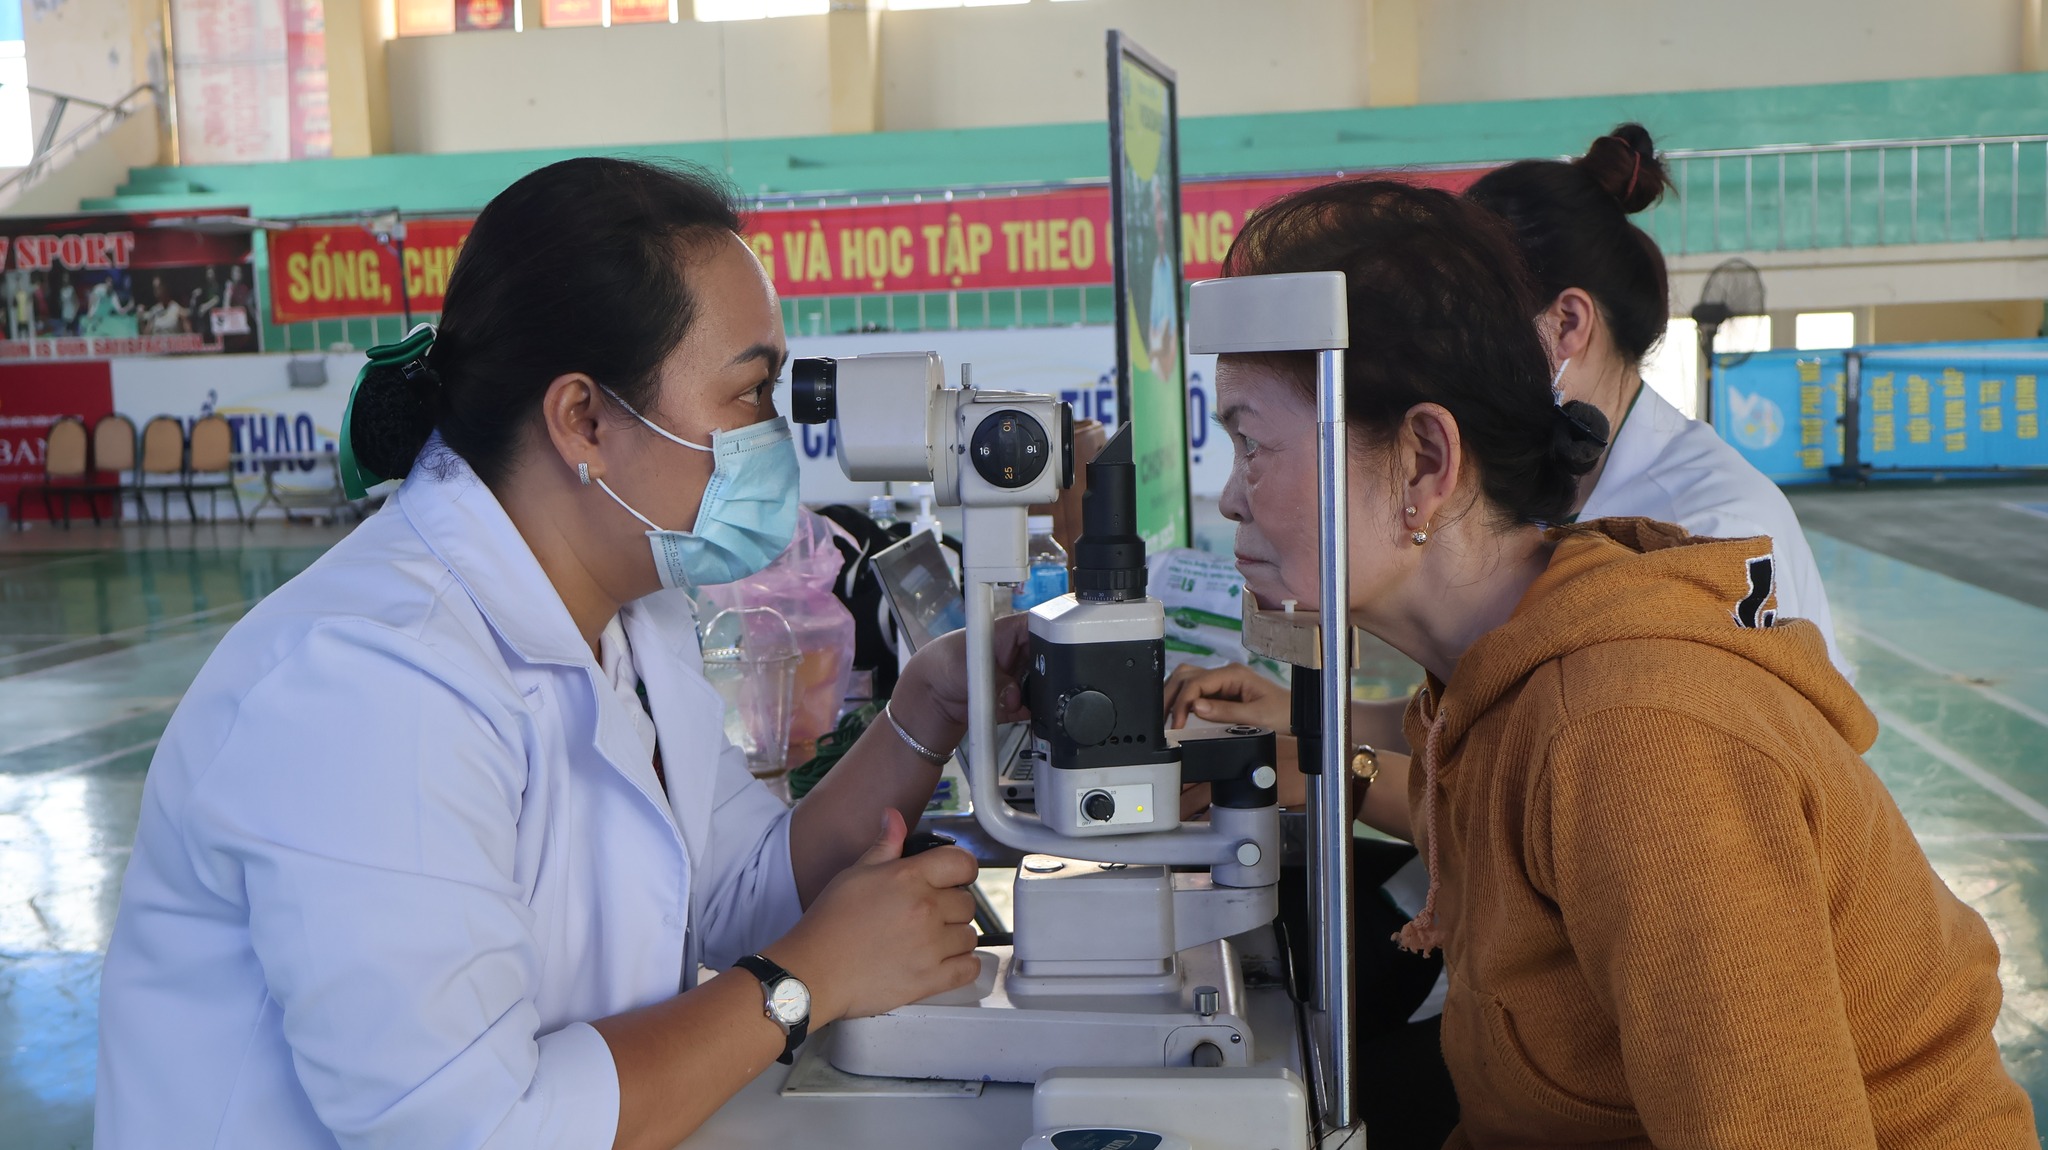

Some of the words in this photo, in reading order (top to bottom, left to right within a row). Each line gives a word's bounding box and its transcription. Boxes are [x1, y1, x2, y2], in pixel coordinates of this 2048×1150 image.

[15, 231, 135, 271] SPORT
[287, 234, 392, 305] SỐNG,
[782, 219, 832, 282] VÀ
[840, 225, 914, 291] HỌC
[922, 213, 993, 287] TẬP
[1002, 217, 1096, 273] THEO
[979, 446, 990, 456] 16
[1004, 466, 1013, 480] 25
